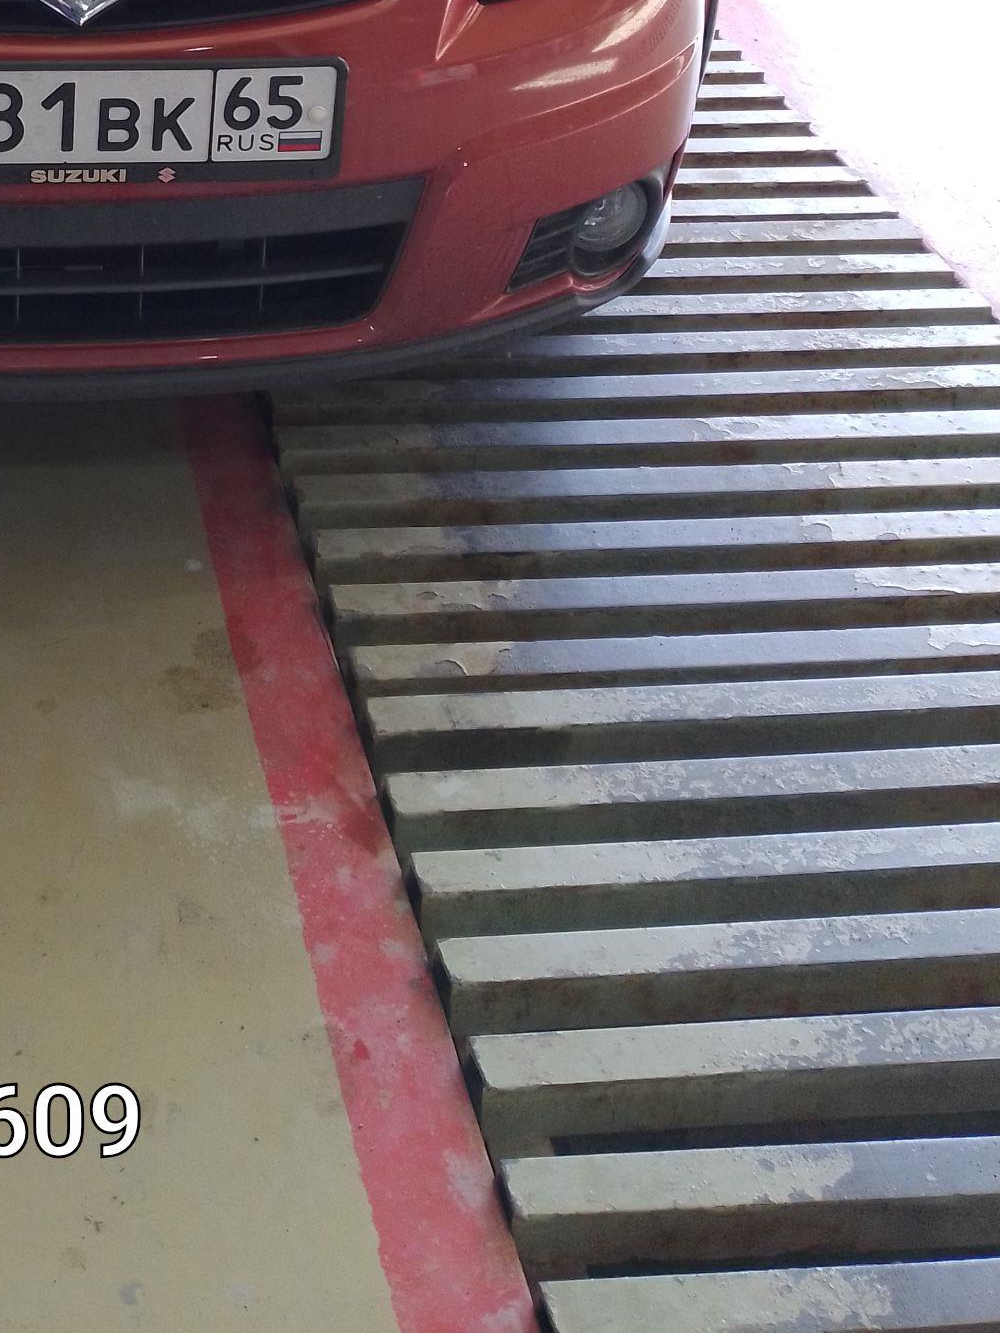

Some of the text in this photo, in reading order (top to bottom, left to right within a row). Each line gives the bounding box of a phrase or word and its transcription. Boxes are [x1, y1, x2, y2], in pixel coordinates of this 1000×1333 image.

[223, 75, 305, 131] 65
[216, 133, 275, 153] RUS
[29, 168, 128, 184] SUZUKI
